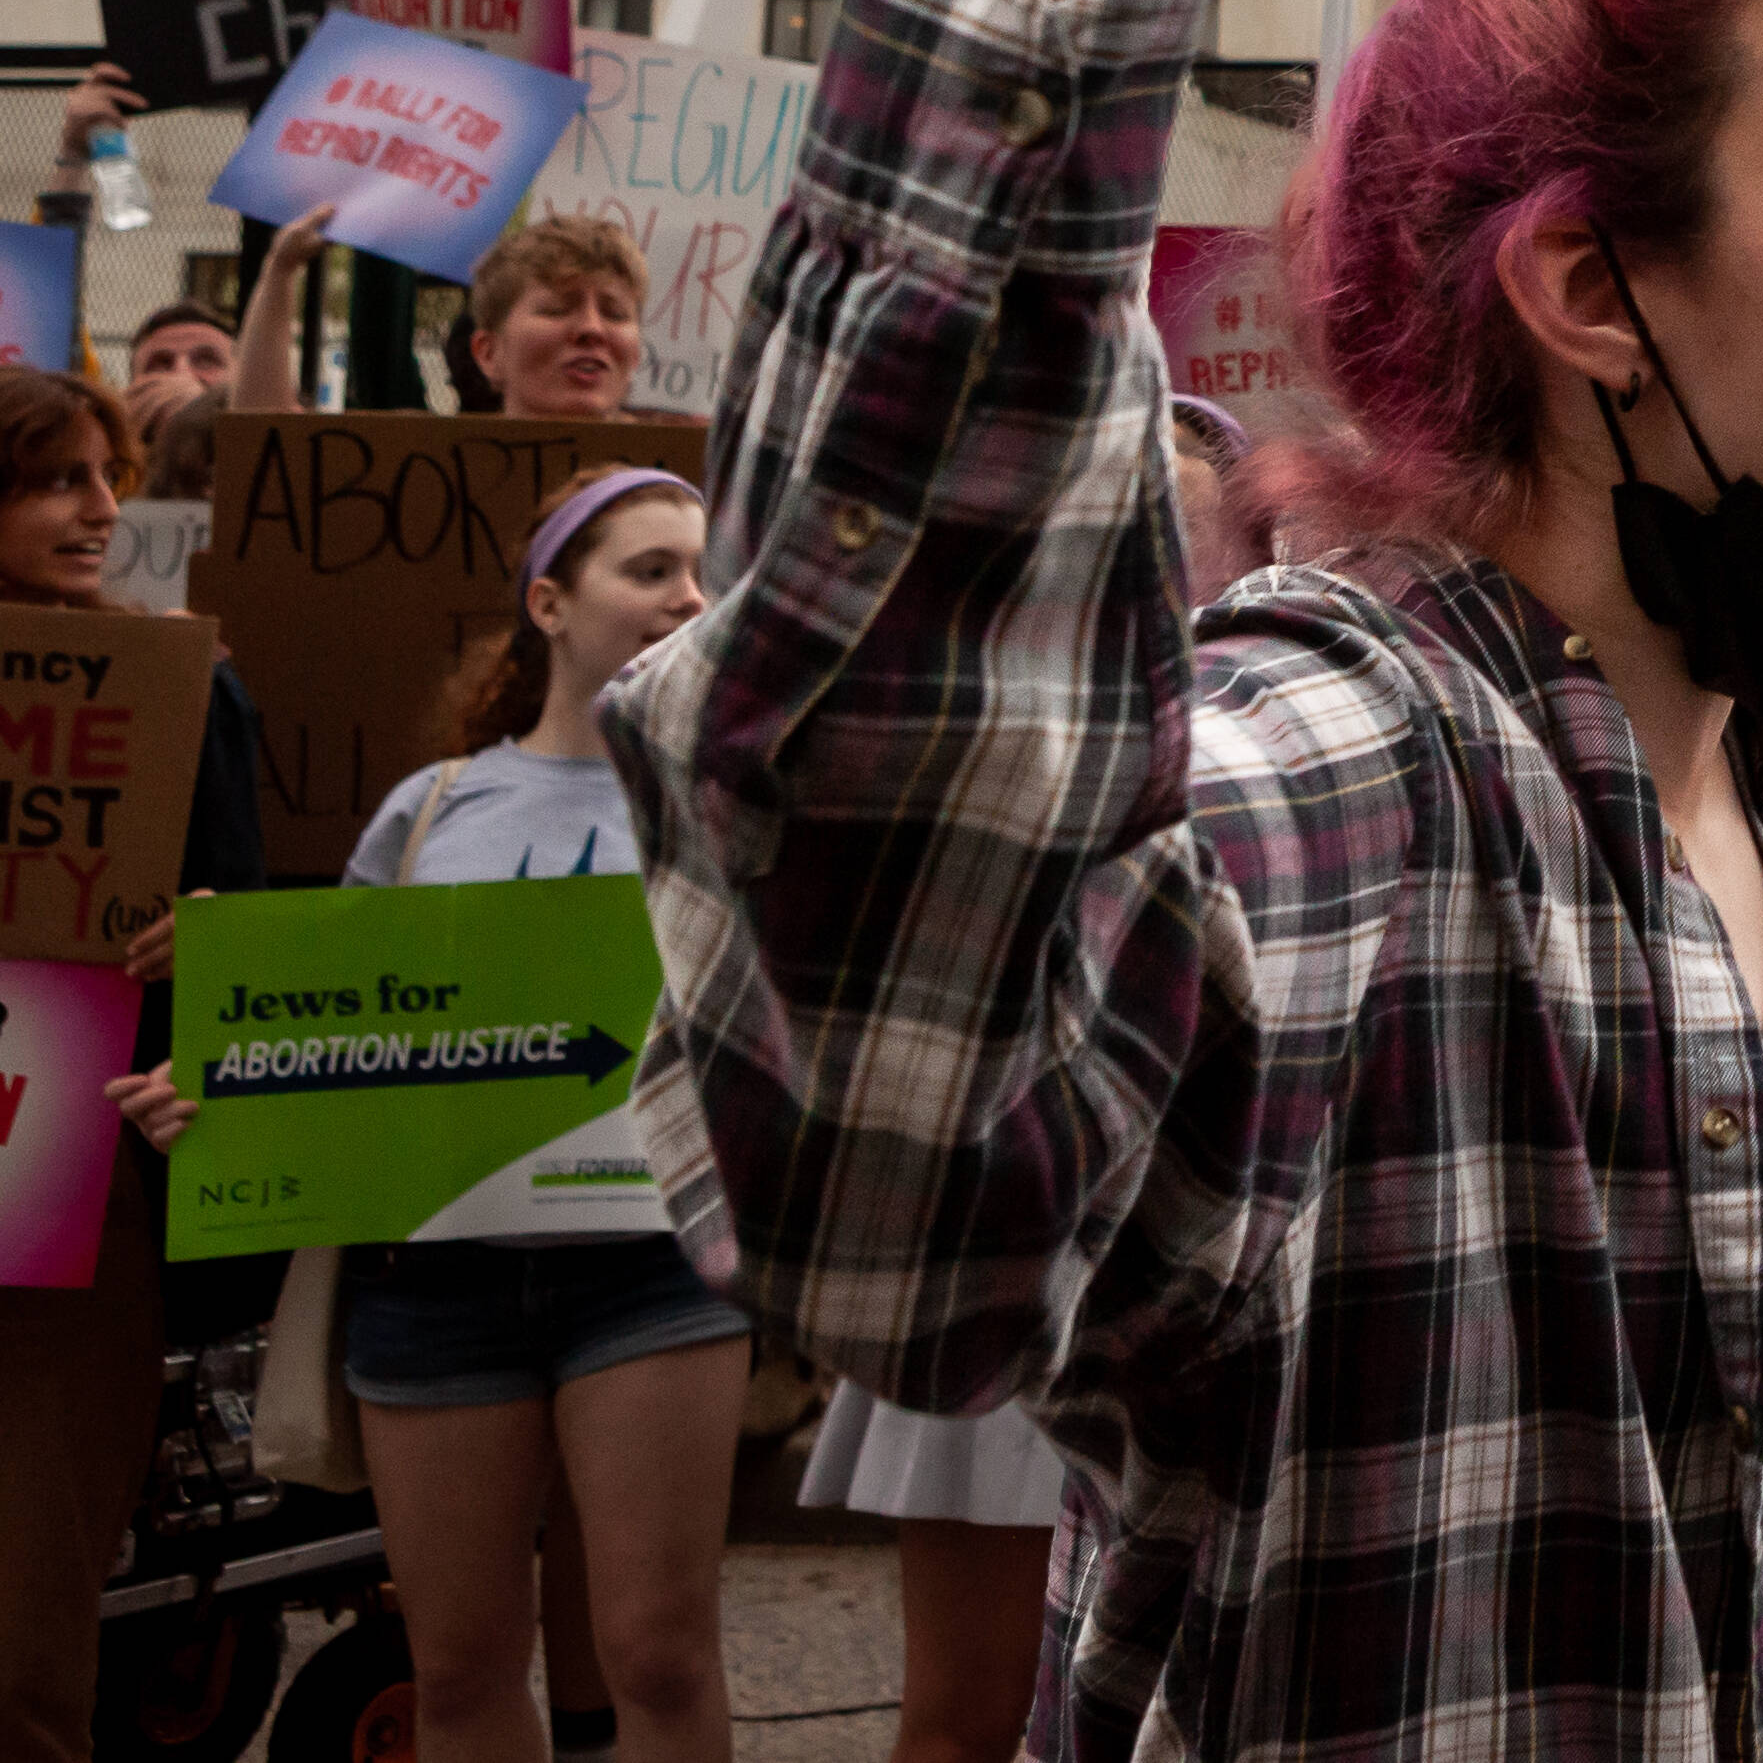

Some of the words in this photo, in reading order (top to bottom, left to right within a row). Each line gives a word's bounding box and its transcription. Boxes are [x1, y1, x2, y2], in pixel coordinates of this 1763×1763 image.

[218, 983, 363, 1024] Jews
[376, 974, 461, 1014] for
[215, 1032, 412, 1084] ABORTION
[418, 1022, 573, 1071] JUSTICE
